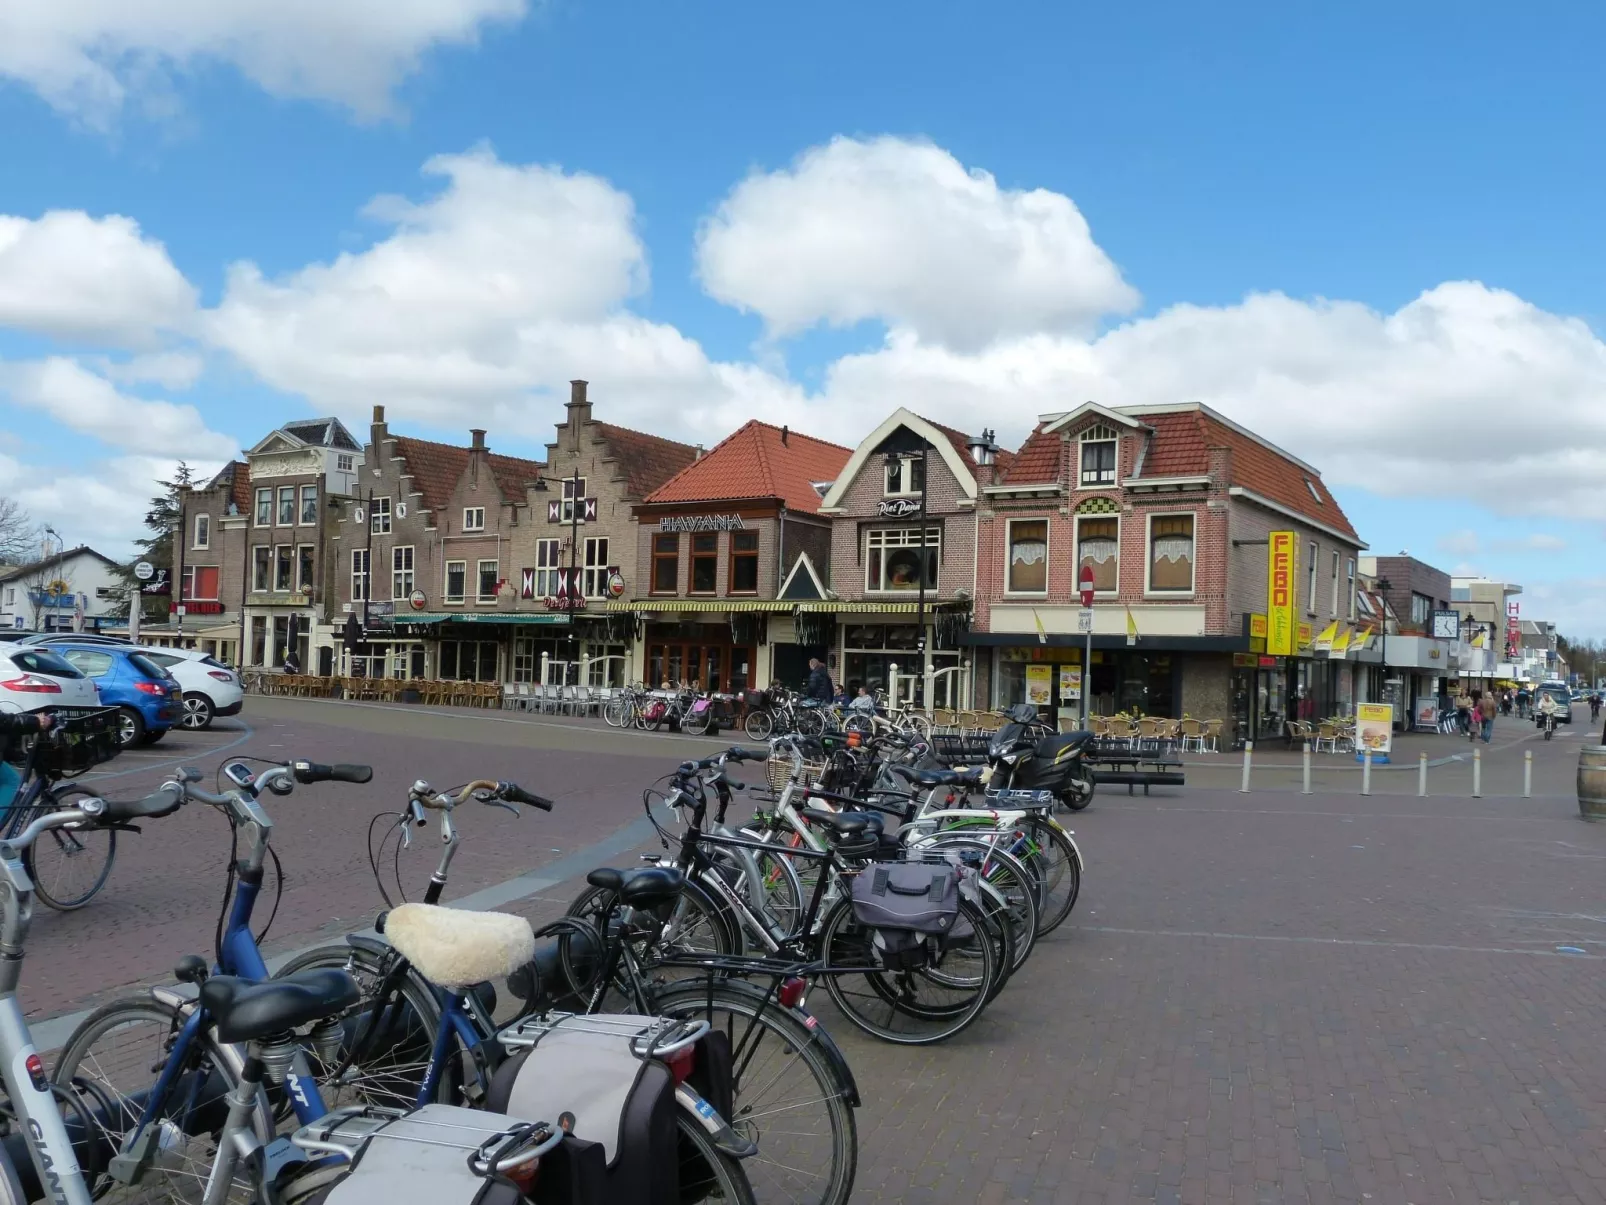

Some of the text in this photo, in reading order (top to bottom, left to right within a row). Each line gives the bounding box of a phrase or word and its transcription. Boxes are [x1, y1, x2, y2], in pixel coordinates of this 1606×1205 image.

[660, 513, 746, 532] HAVANA
[1273, 534, 1289, 607] FEBO
[557, 596, 588, 610] Geel
[421, 1055, 435, 1092] TWIST
[26, 1117, 70, 1205] GIANT
